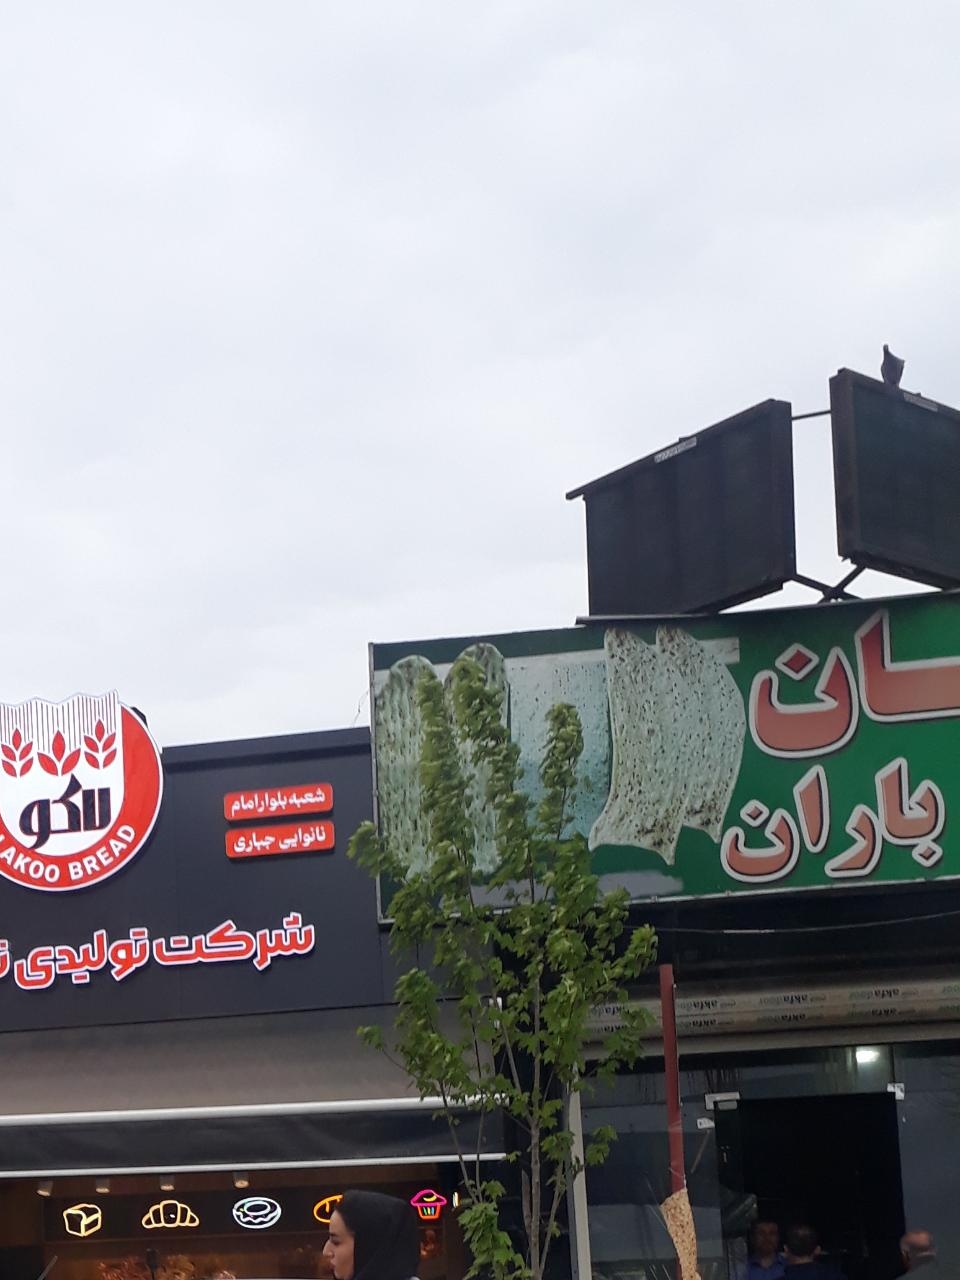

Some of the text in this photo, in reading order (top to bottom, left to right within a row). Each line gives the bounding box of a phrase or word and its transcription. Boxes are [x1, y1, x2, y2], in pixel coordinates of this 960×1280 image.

[19, 773, 111, 850] لاکو
[288, 787, 326, 809] شعبه
[720, 756, 945, 882] باران
[68, 824, 136, 881] BREAD
[233, 825, 327, 853] نانوایی جباری
[13, 927, 149, 989] تولیدی
[155, 912, 315, 970] شرکت
